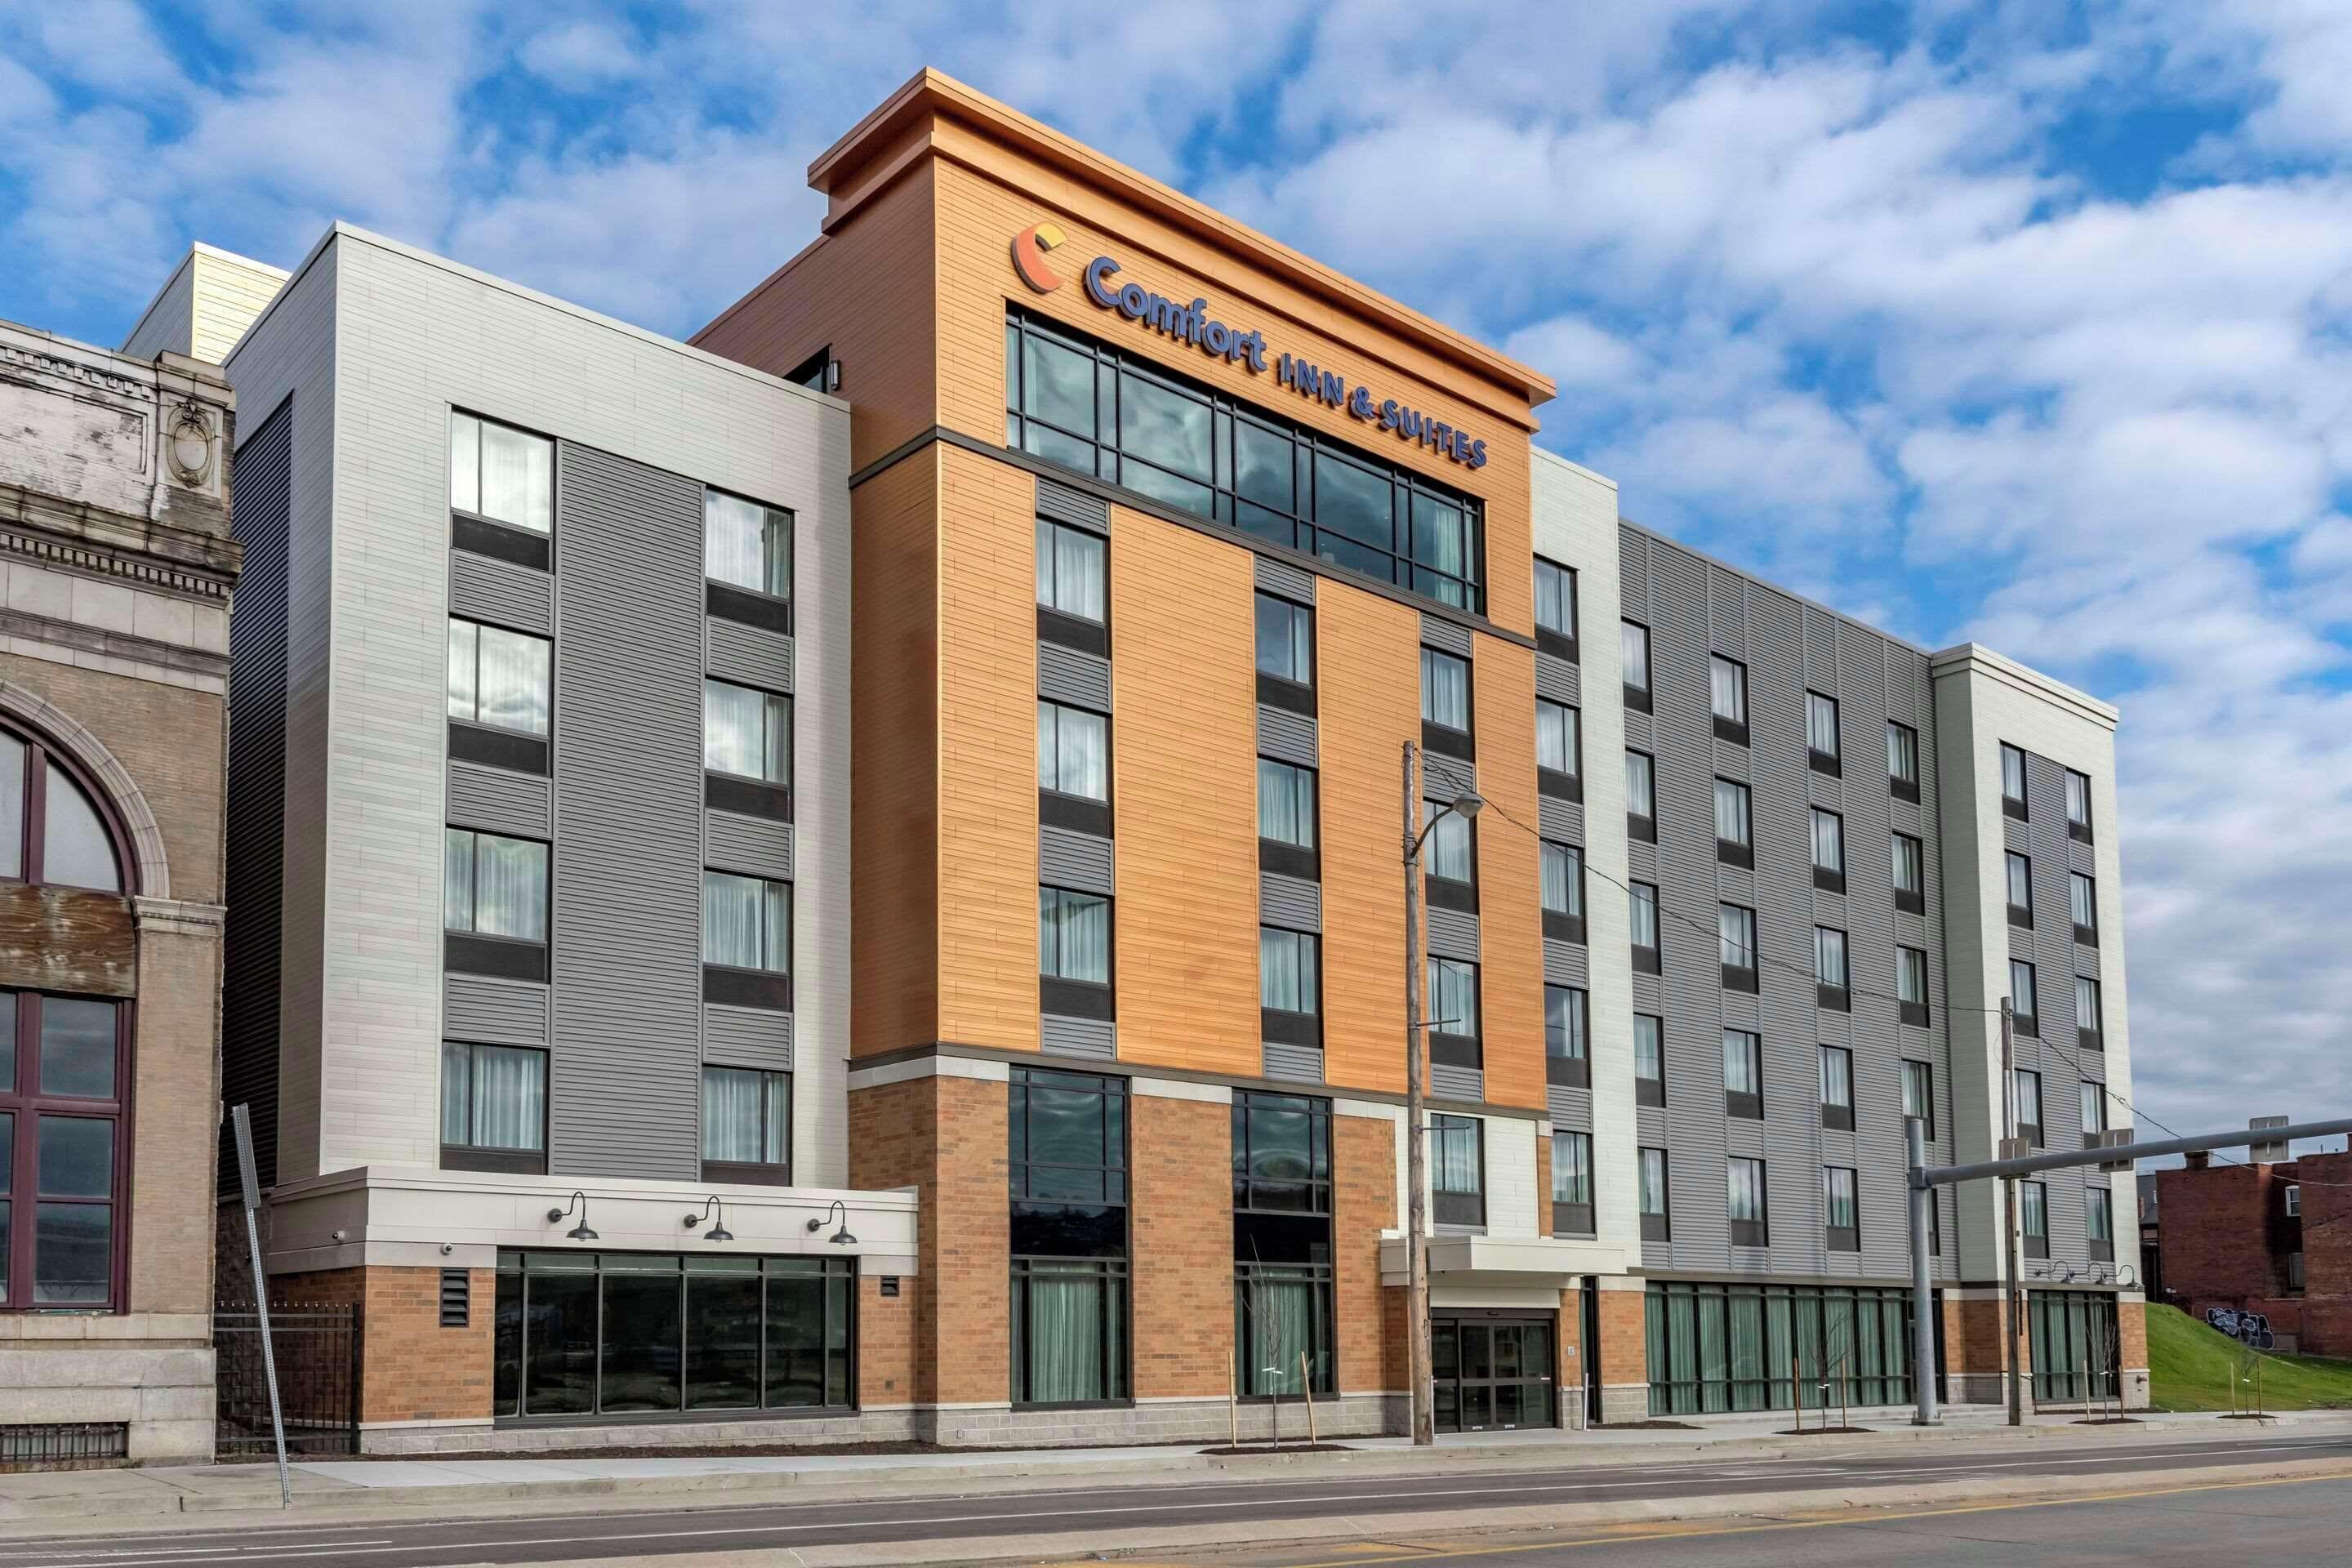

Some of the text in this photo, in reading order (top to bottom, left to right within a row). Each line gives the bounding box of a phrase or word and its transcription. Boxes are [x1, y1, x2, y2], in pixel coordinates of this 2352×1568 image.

[1085, 256, 1487, 468] Comfort INN & SUITES
